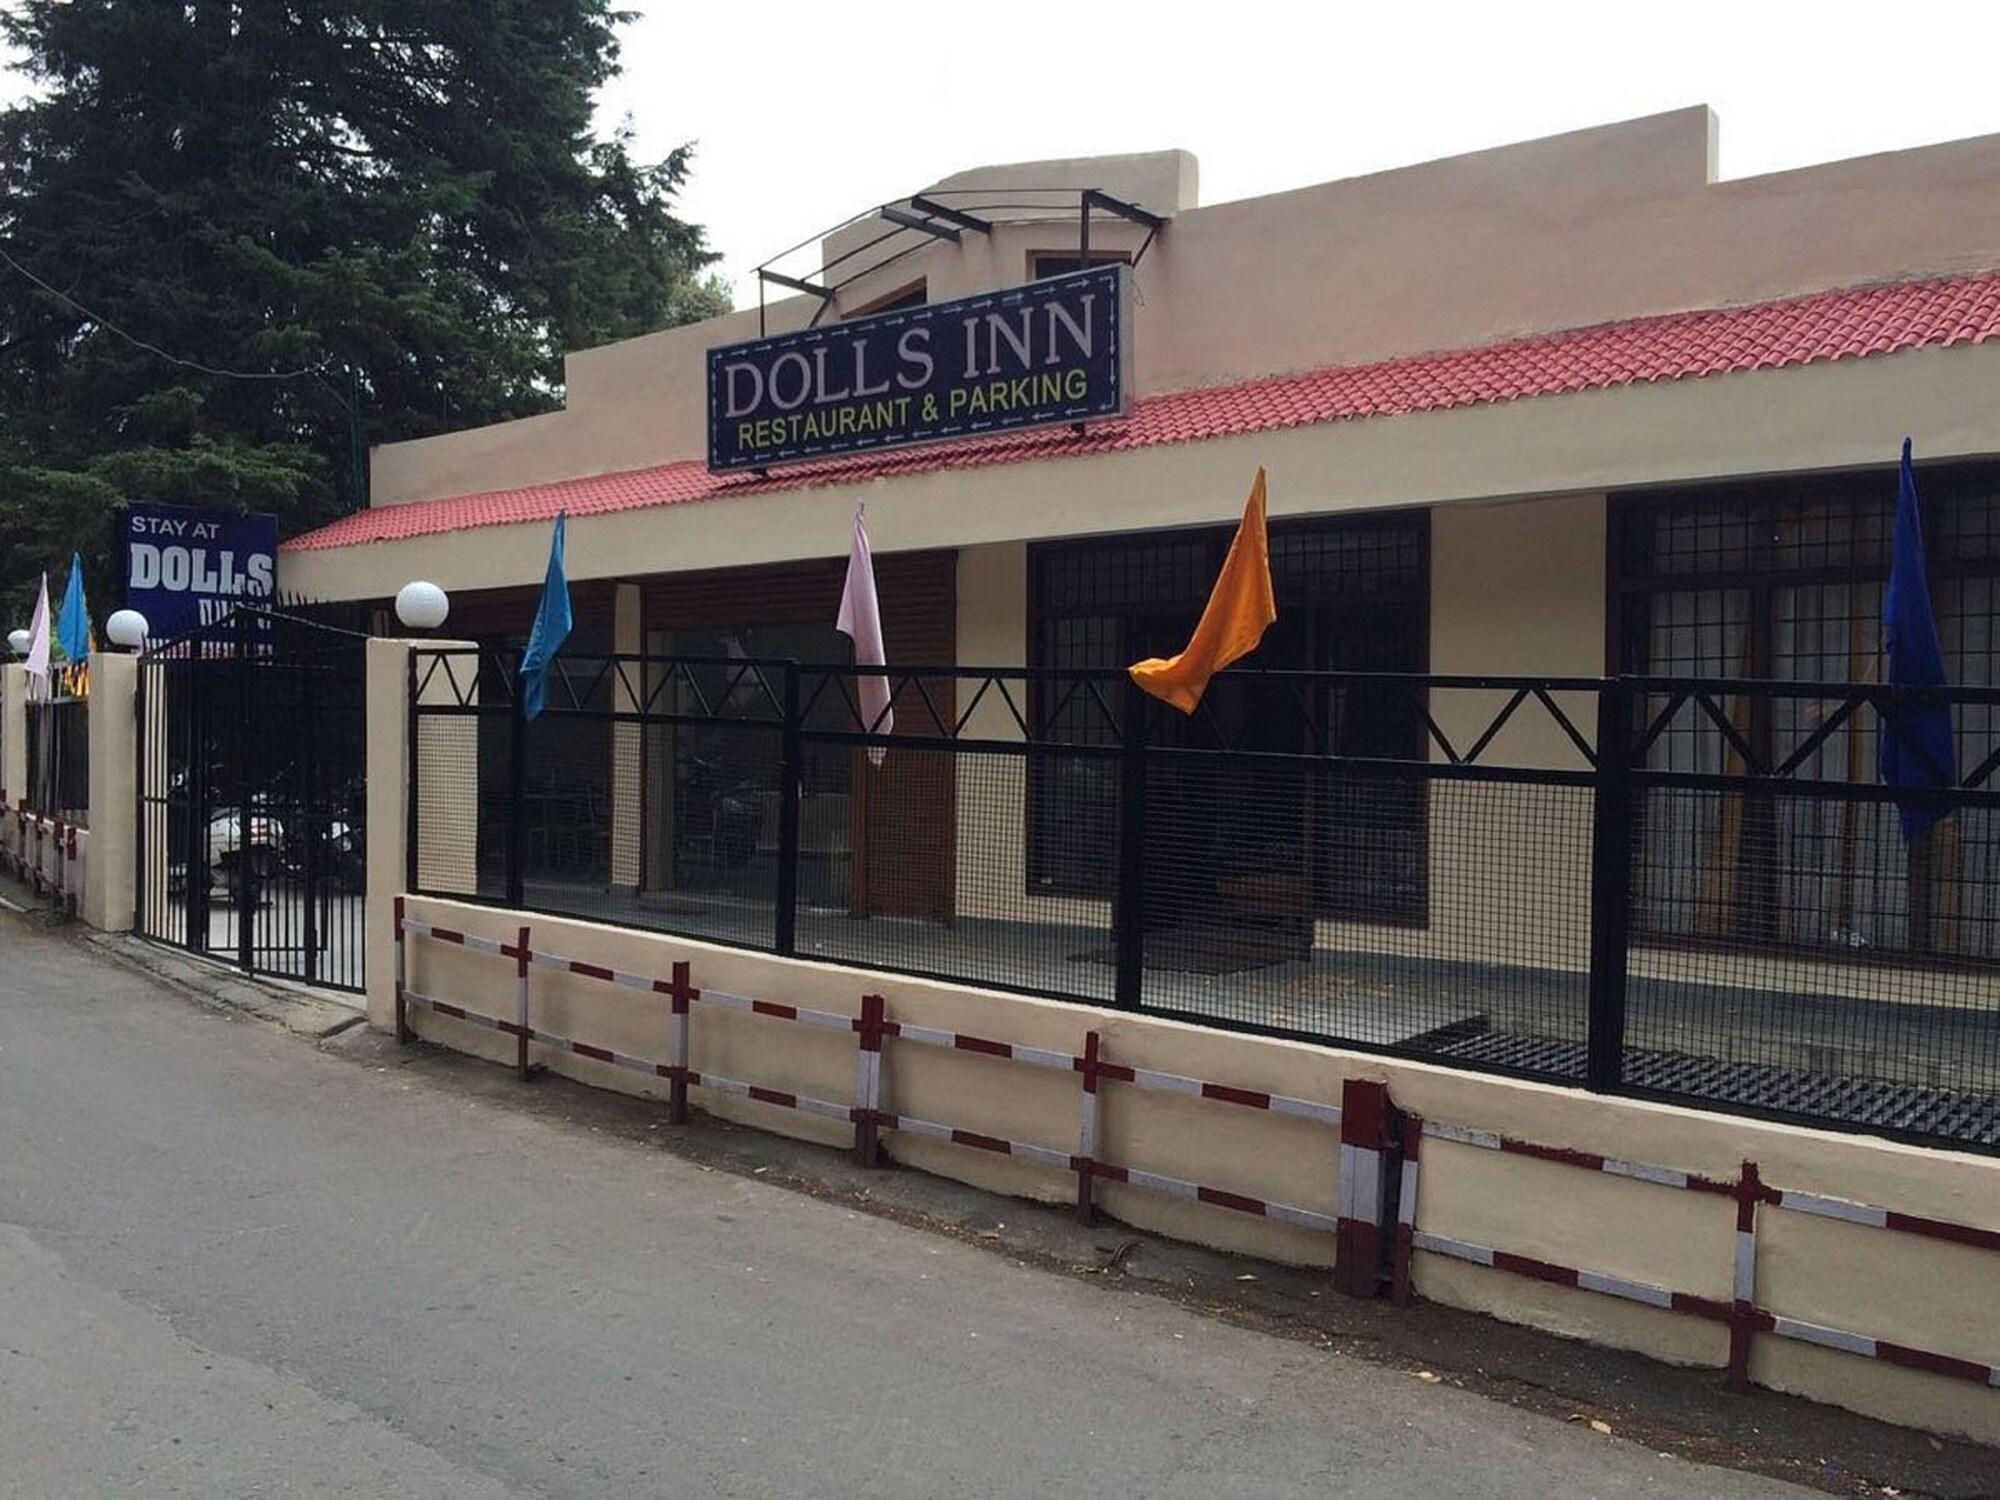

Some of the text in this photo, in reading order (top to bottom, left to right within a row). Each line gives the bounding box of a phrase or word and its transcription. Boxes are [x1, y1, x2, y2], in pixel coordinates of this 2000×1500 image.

[725, 294, 1096, 418] DOLLS INN
[738, 370, 1088, 450] RESTAURANT & PARKING
[132, 516, 220, 539] STAY AT
[130, 543, 273, 597] DOLLS
